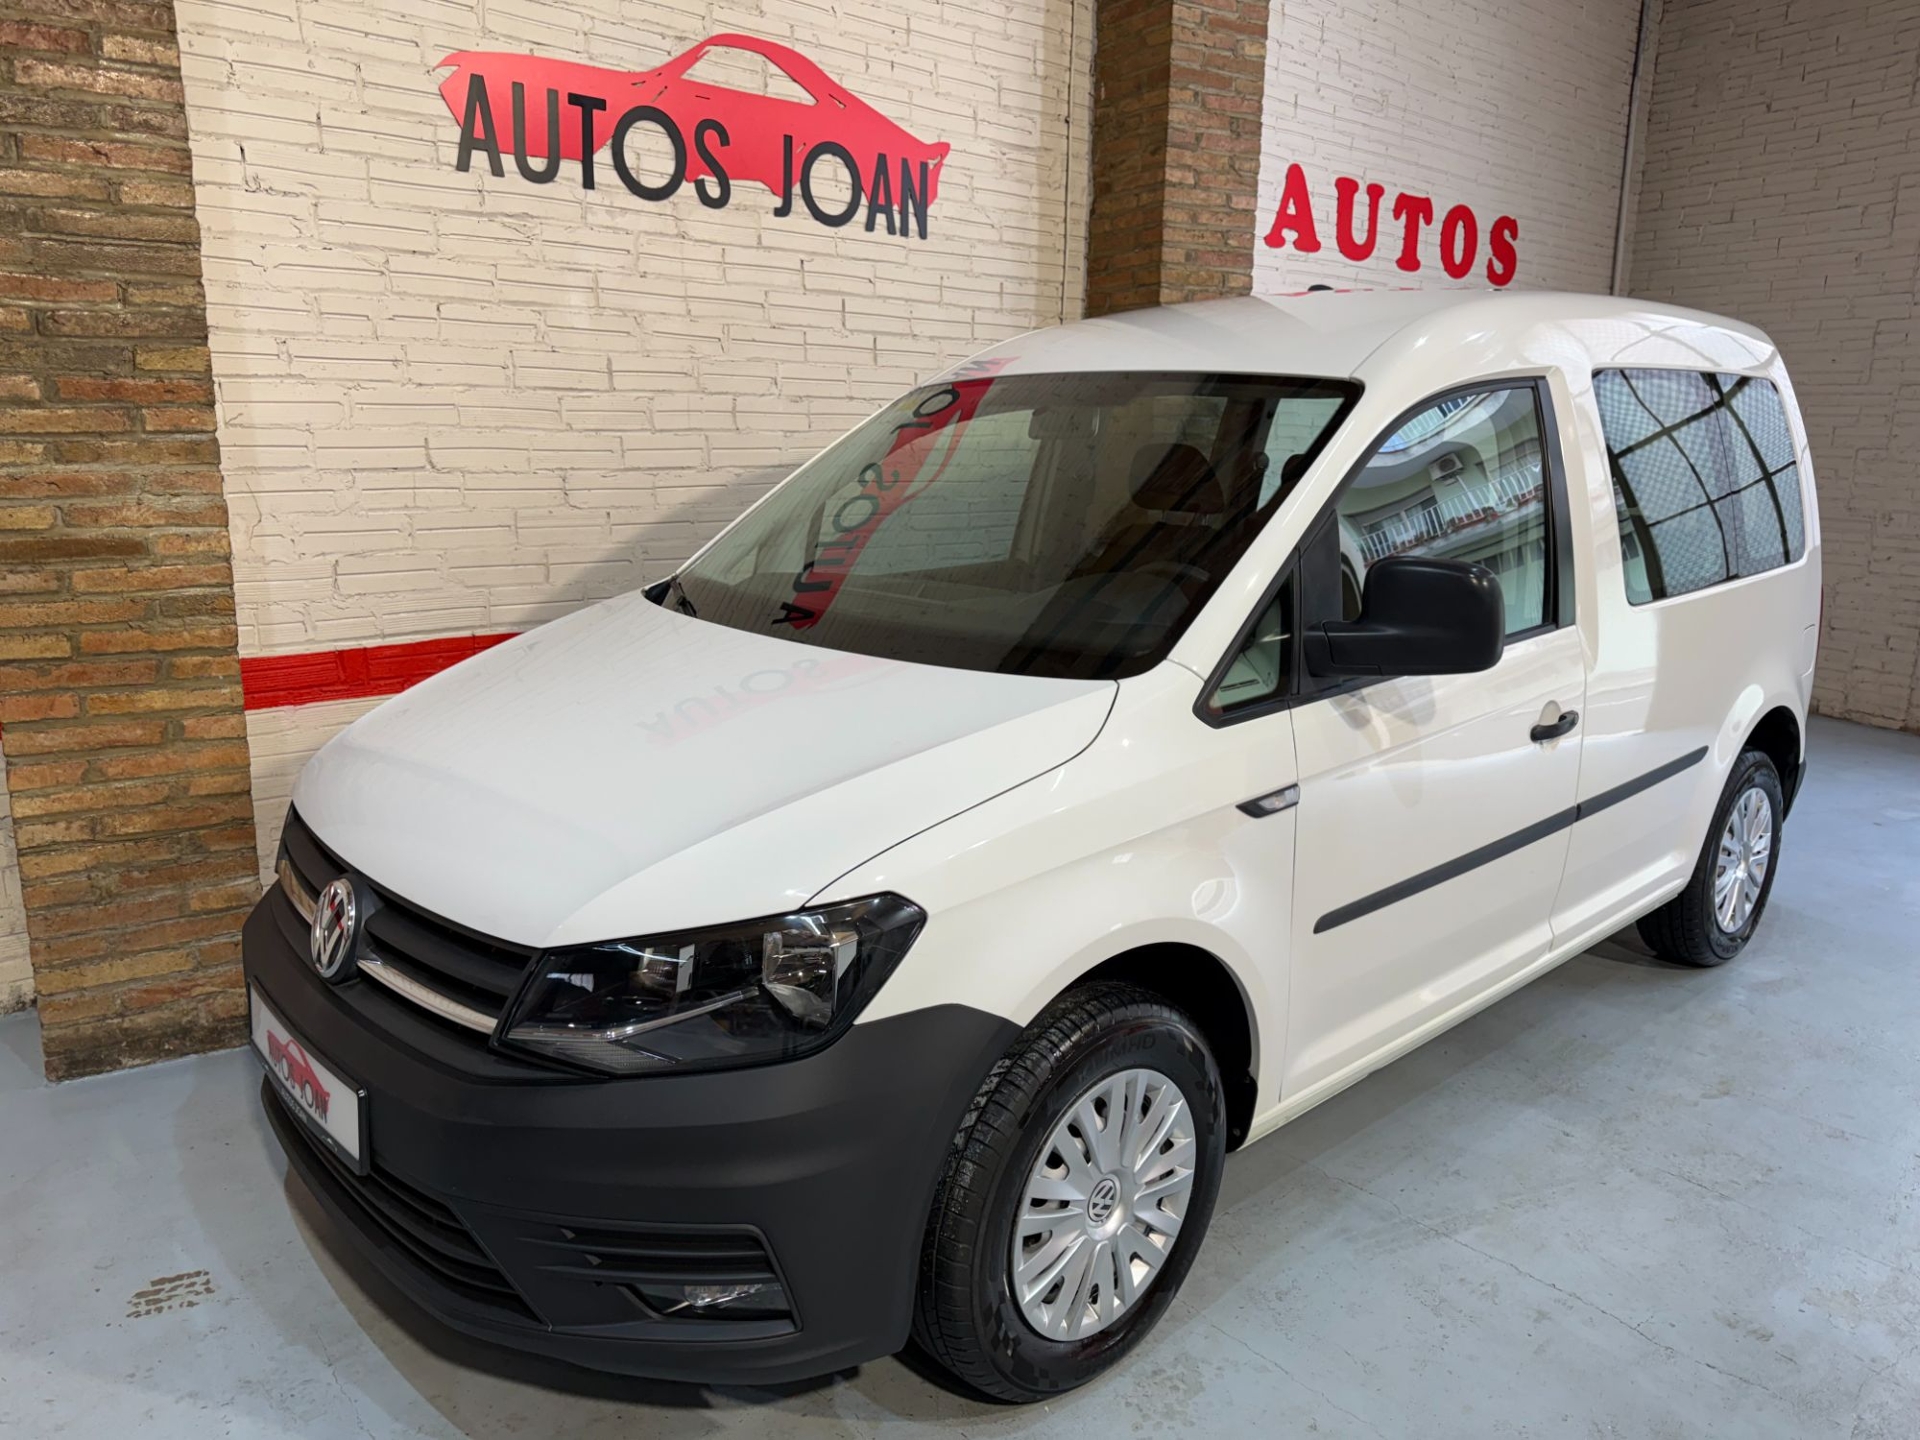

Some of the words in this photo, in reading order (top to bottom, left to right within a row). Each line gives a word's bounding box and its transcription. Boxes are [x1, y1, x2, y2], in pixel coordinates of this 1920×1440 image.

[456, 73, 731, 210] AUTOS
[774, 134, 928, 240] JOAN
[1264, 163, 1518, 286] AUTOS
